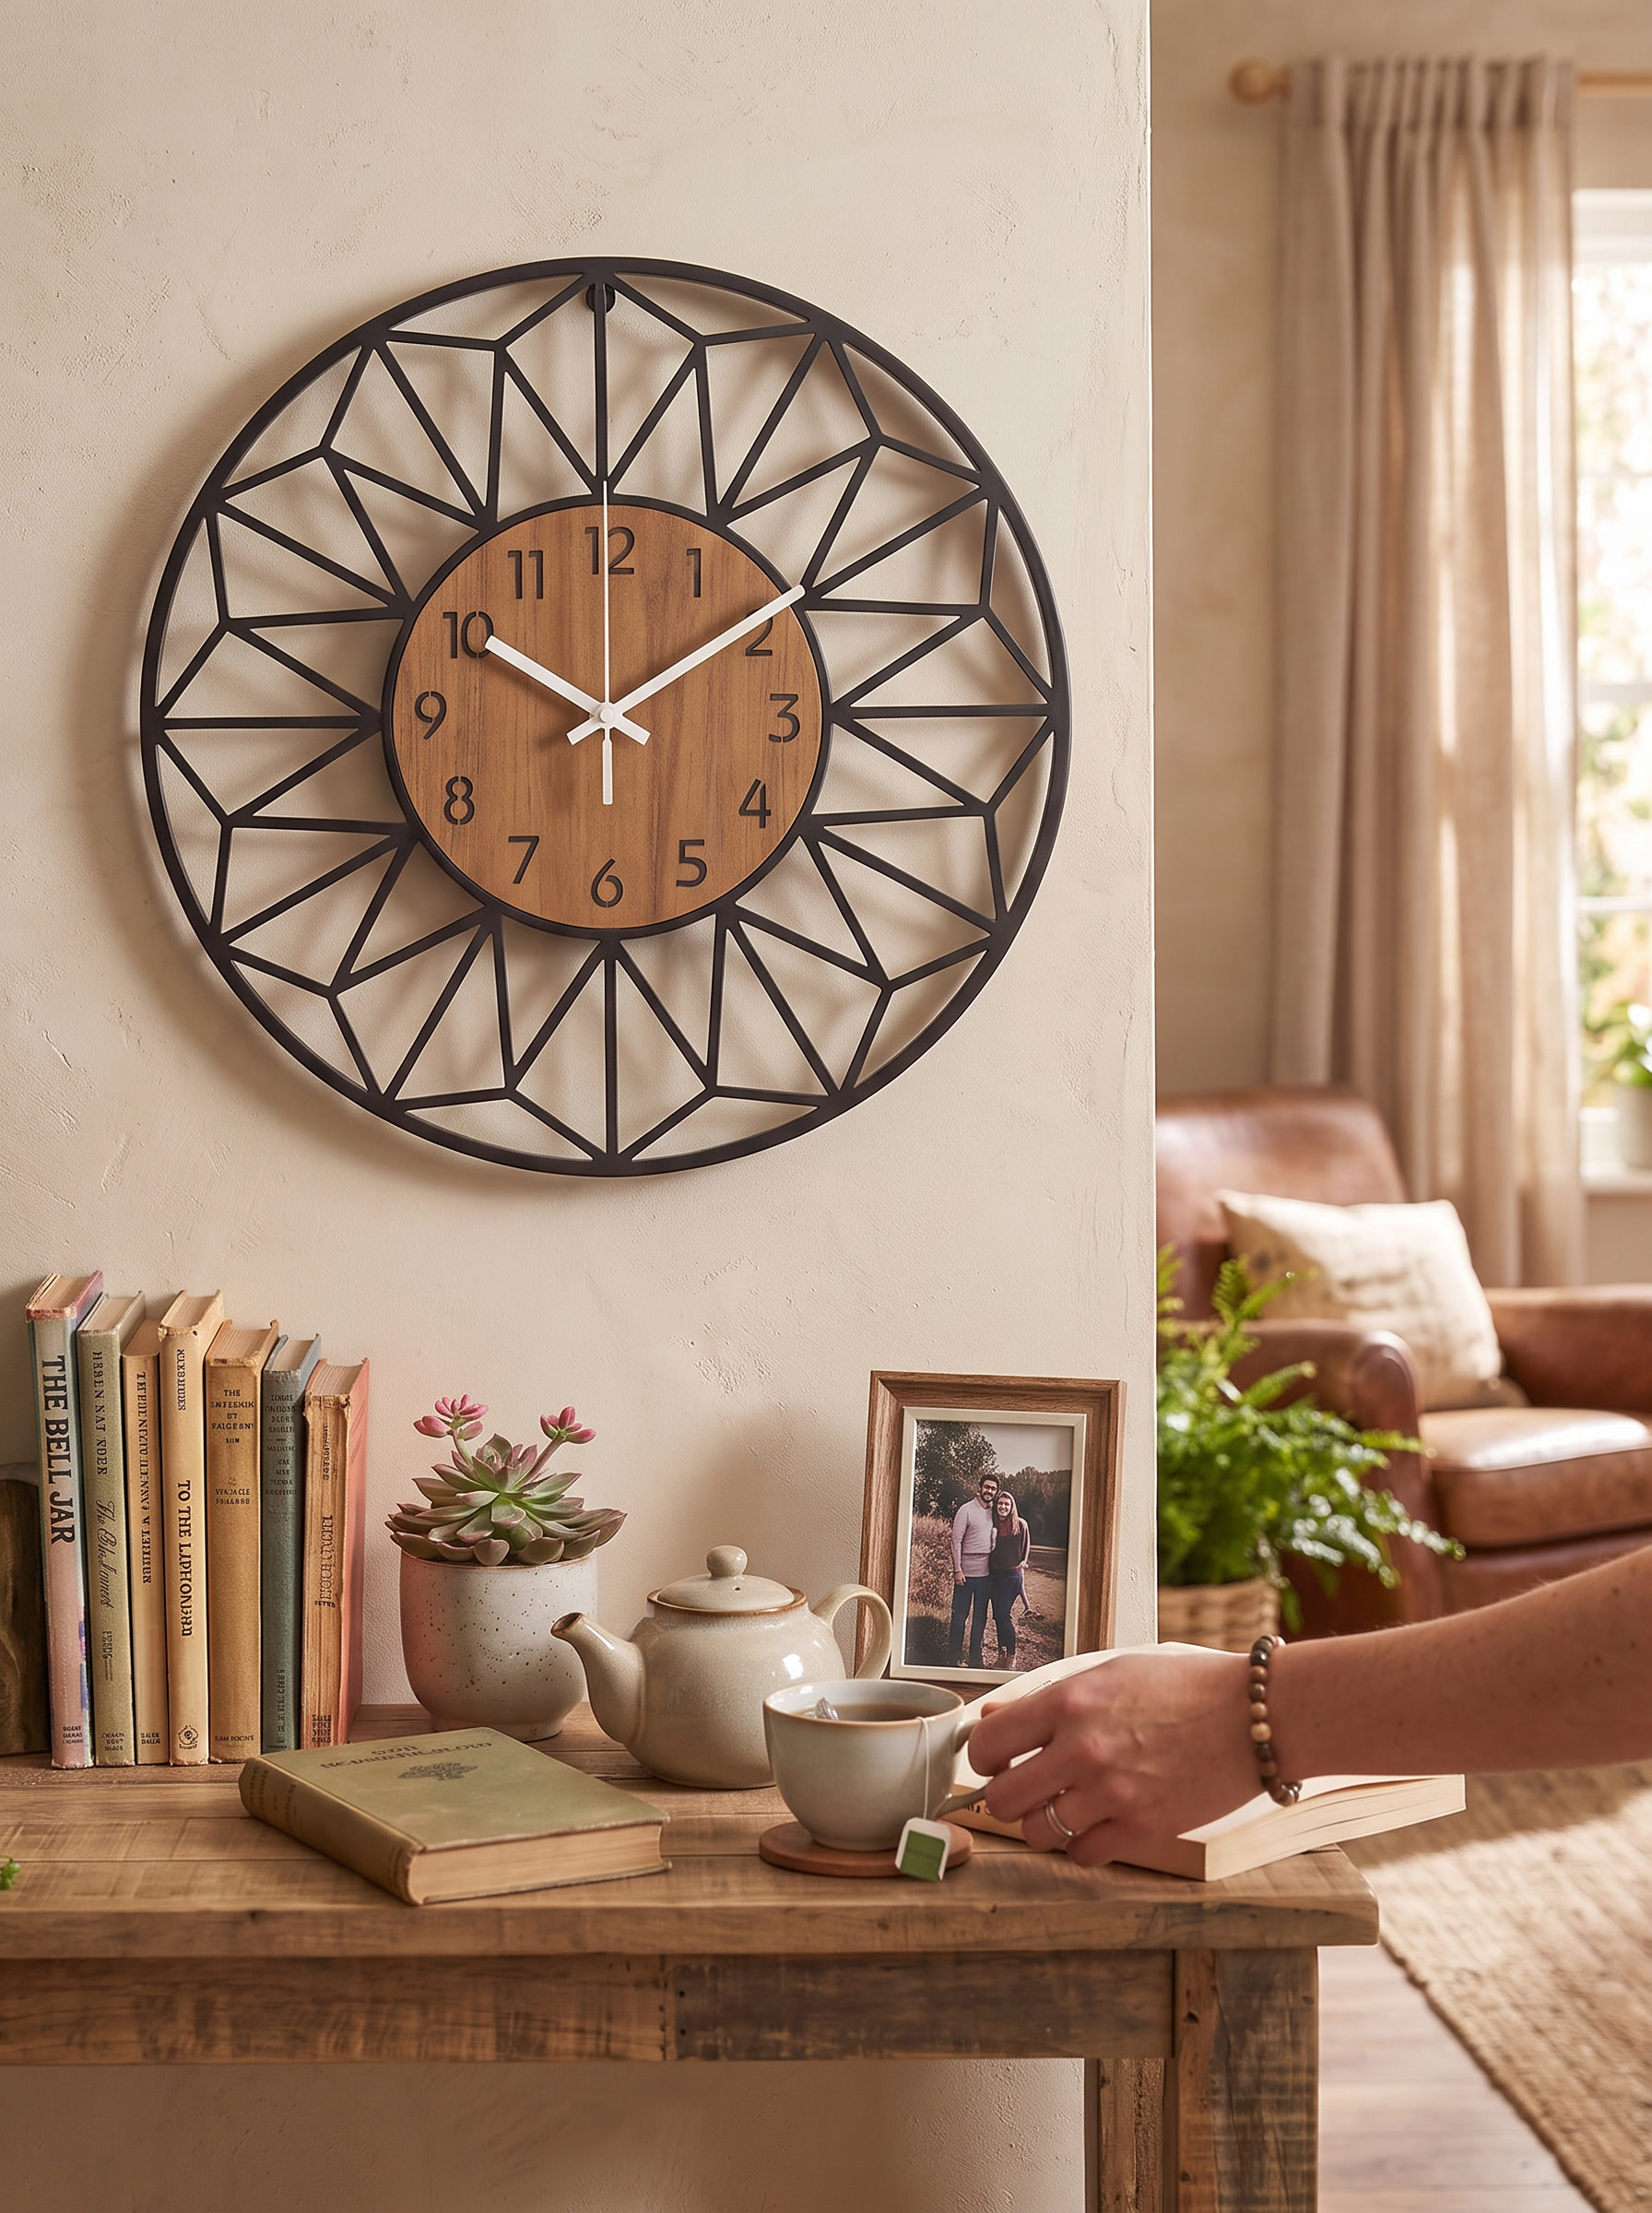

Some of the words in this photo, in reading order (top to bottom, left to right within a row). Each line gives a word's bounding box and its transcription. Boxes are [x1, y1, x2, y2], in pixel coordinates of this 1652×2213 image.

[507, 550, 544, 599] 11
[584, 527, 636, 575] 12
[686, 548, 702, 598] 1
[442, 610, 494, 659] 10
[744, 609, 774, 657] 2
[414, 691, 447, 740] 9
[768, 693, 801, 743] 3
[443, 775, 475, 825] 8
[738, 778, 772, 829] 4
[508, 835, 540, 884] 7
[591, 858, 624, 908] 6
[676, 839, 708, 887] 5
[41, 1355, 68, 1411] THE
[223, 1389, 241, 1397] THE
[44, 1417, 72, 1485] BELL
[178, 1480, 191, 1502] TO
[49, 1491, 76, 1545] JAR
[179, 1506, 192, 1538] THE
